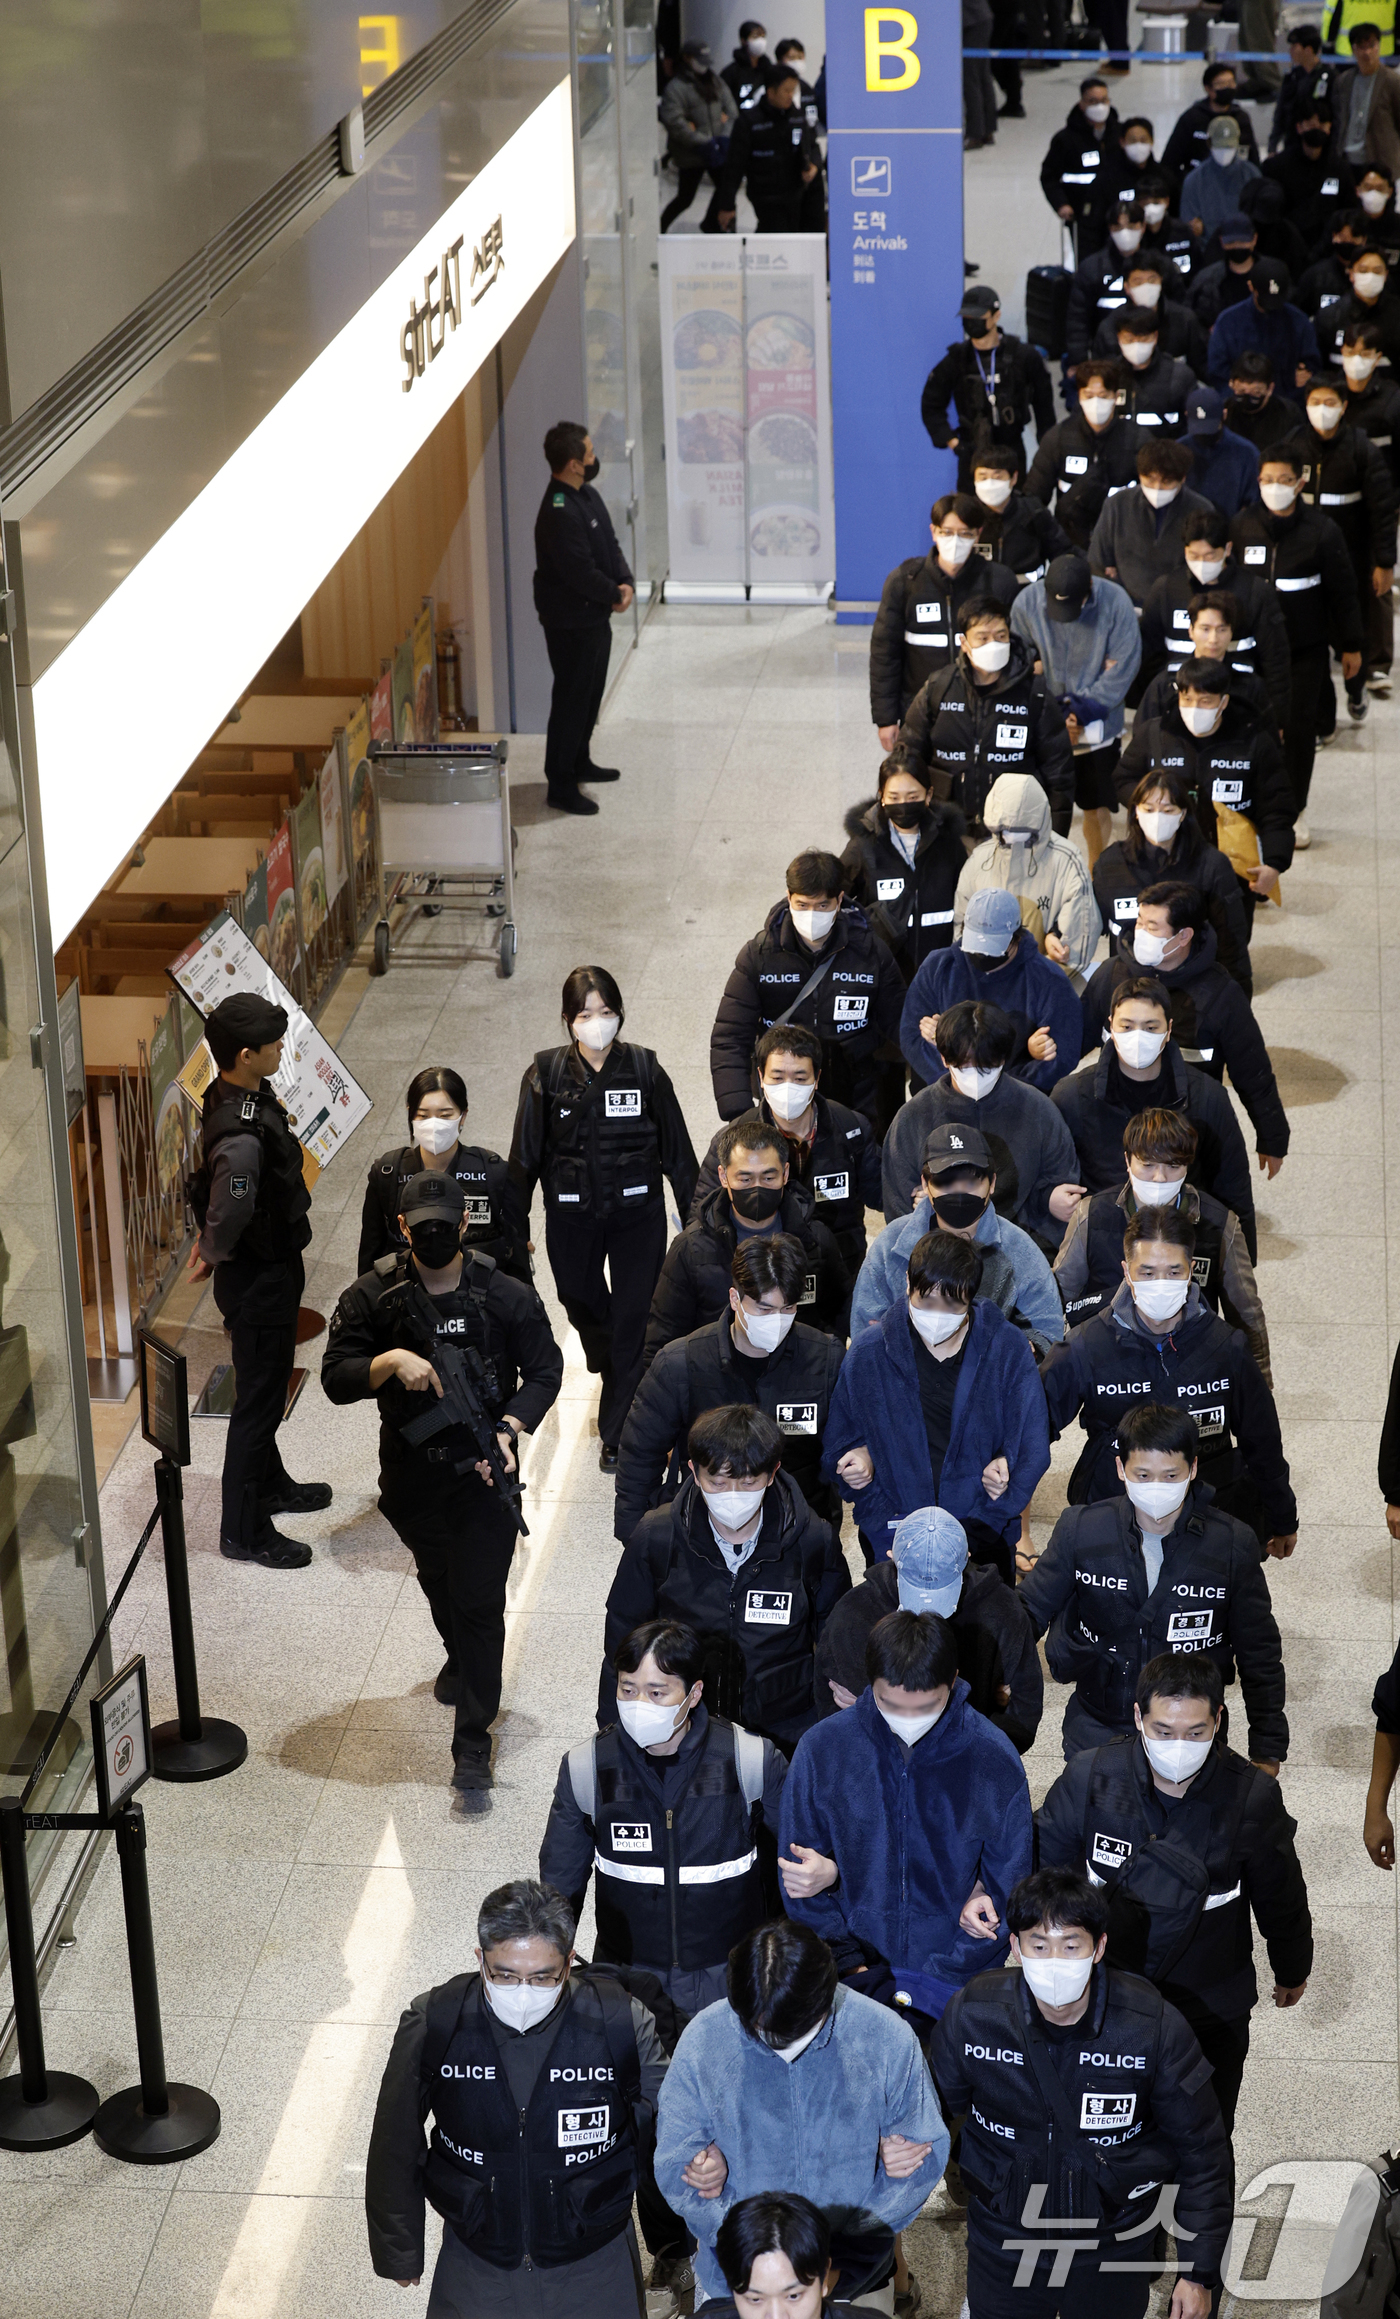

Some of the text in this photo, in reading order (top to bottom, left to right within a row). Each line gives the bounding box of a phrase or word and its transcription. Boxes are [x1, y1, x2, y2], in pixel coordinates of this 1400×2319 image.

[864, 7, 922, 92] B
[852, 210, 887, 232] 도착
[852, 234, 908, 251] Arrivals
[939, 701, 965, 713] OLICE
[995, 703, 1028, 715] POLIC
[987, 752, 1024, 763] POLICE
[1211, 759, 1250, 770] POLICE
[759, 973, 801, 984] POLICE
[832, 972, 874, 984] POLICE
[839, 999, 865, 1011] 형사
[836, 1018, 868, 1033] POLIC
[314, 1056, 325, 1071] ASIAN
[317, 1062, 332, 1079] NOODLE
[610, 1094, 637, 1106] 경찰
[950, 1135, 964, 1149] LA
[455, 1171, 487, 1182] POLIC
[818, 1177, 844, 1190] 형사
[463, 1200, 489, 1213] 경찰
[468, 1214, 490, 1222] TERPOL
[1194, 1259, 1206, 1273] 사
[1065, 1293, 1103, 1313] Supreme
[436, 1319, 466, 1335] LICE
[1096, 1381, 1152, 1396] POLICE
[1177, 1378, 1231, 1397] POLICE
[780, 1408, 813, 1421] 형사
[1075, 1569, 1128, 1591] POLICE
[751, 1594, 786, 1609] 형사
[748, 1610, 787, 1620] DETECTIVE
[1177, 1617, 1206, 1629] 경찰
[1173, 1629, 1206, 1639] POLICE
[1172, 1632, 1223, 1654] POLICE
[25, 1815, 60, 1829] rEAT
[617, 1826, 645, 1839] 수사
[616, 1841, 648, 1849] POLICE
[1099, 1839, 1126, 1856] 수사
[964, 2043, 1024, 2067] POLICE
[1079, 2051, 1146, 2071] POLICE
[440, 2064, 497, 2081] OLICE
[549, 2067, 615, 2083] POLICE
[1089, 2099, 1129, 2115] 형사
[564, 2111, 604, 2131] 형사
[971, 2104, 1016, 2141] POLICE
[1085, 2115, 1129, 2126] DETECTIVE
[563, 2129, 605, 2143] DETECTIVE
[439, 2128, 484, 2166] POLICE
[565, 2133, 618, 2167] POLICE
